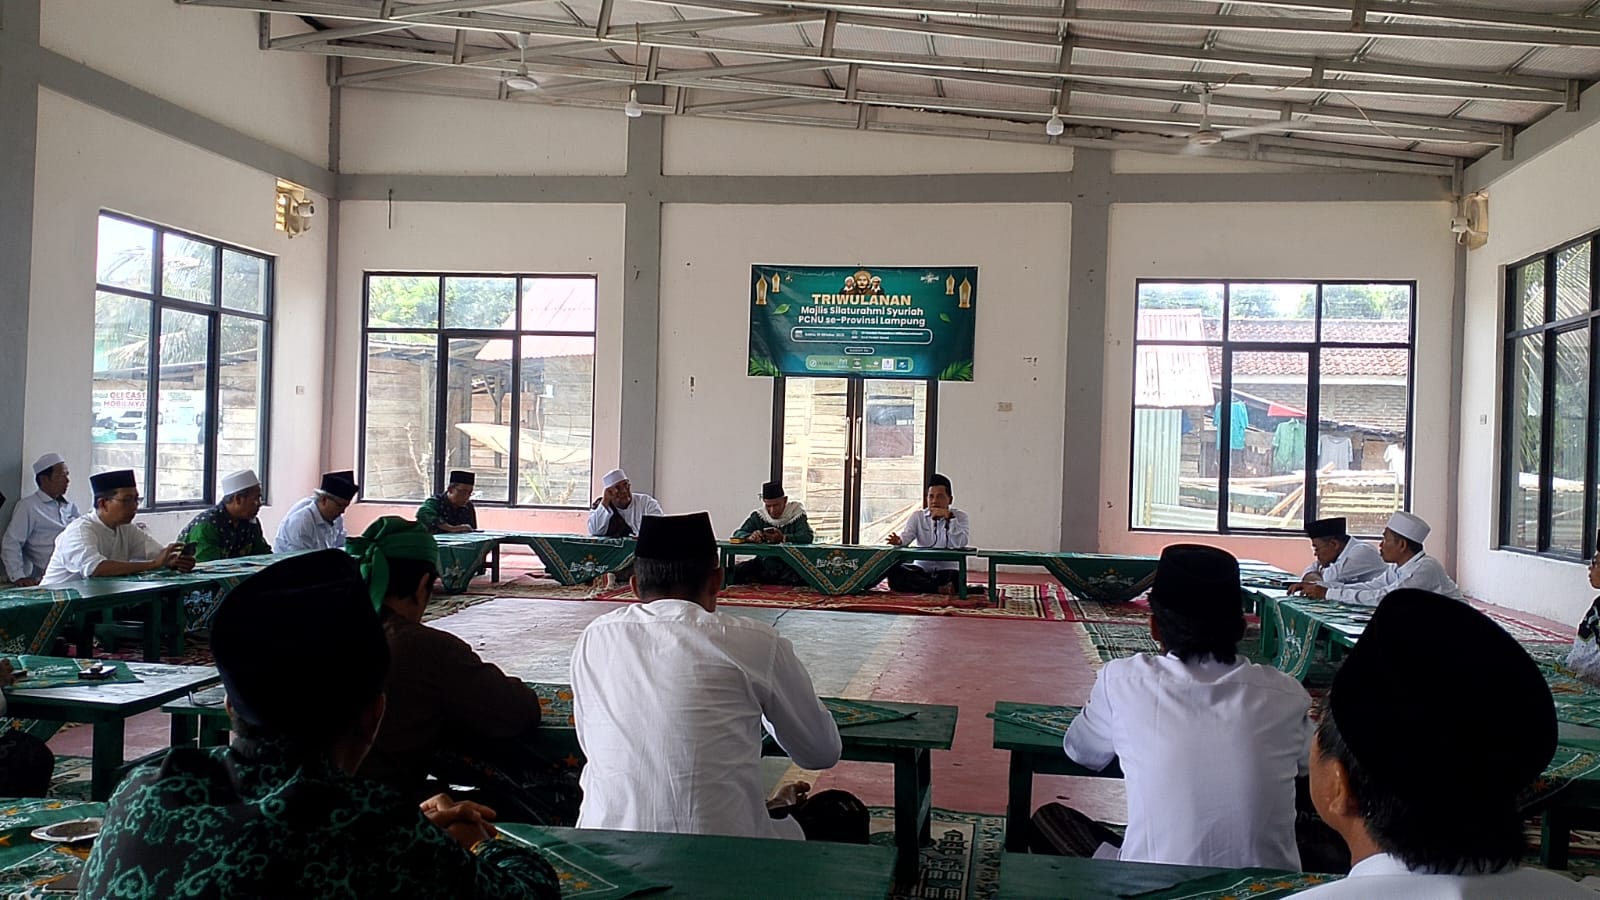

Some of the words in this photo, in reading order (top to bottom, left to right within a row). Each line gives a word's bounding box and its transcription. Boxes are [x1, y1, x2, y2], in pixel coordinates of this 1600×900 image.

[811, 293, 912, 306] TRIWULANAN
[801, 305, 828, 317] Majlis
[829, 306, 885, 316] Silaturahmi
[886, 307, 924, 317] Syuriah
[798, 315, 824, 324] PCNU
[825, 315, 879, 325] se-Provinsi
[880, 316, 926, 327] Lampung
